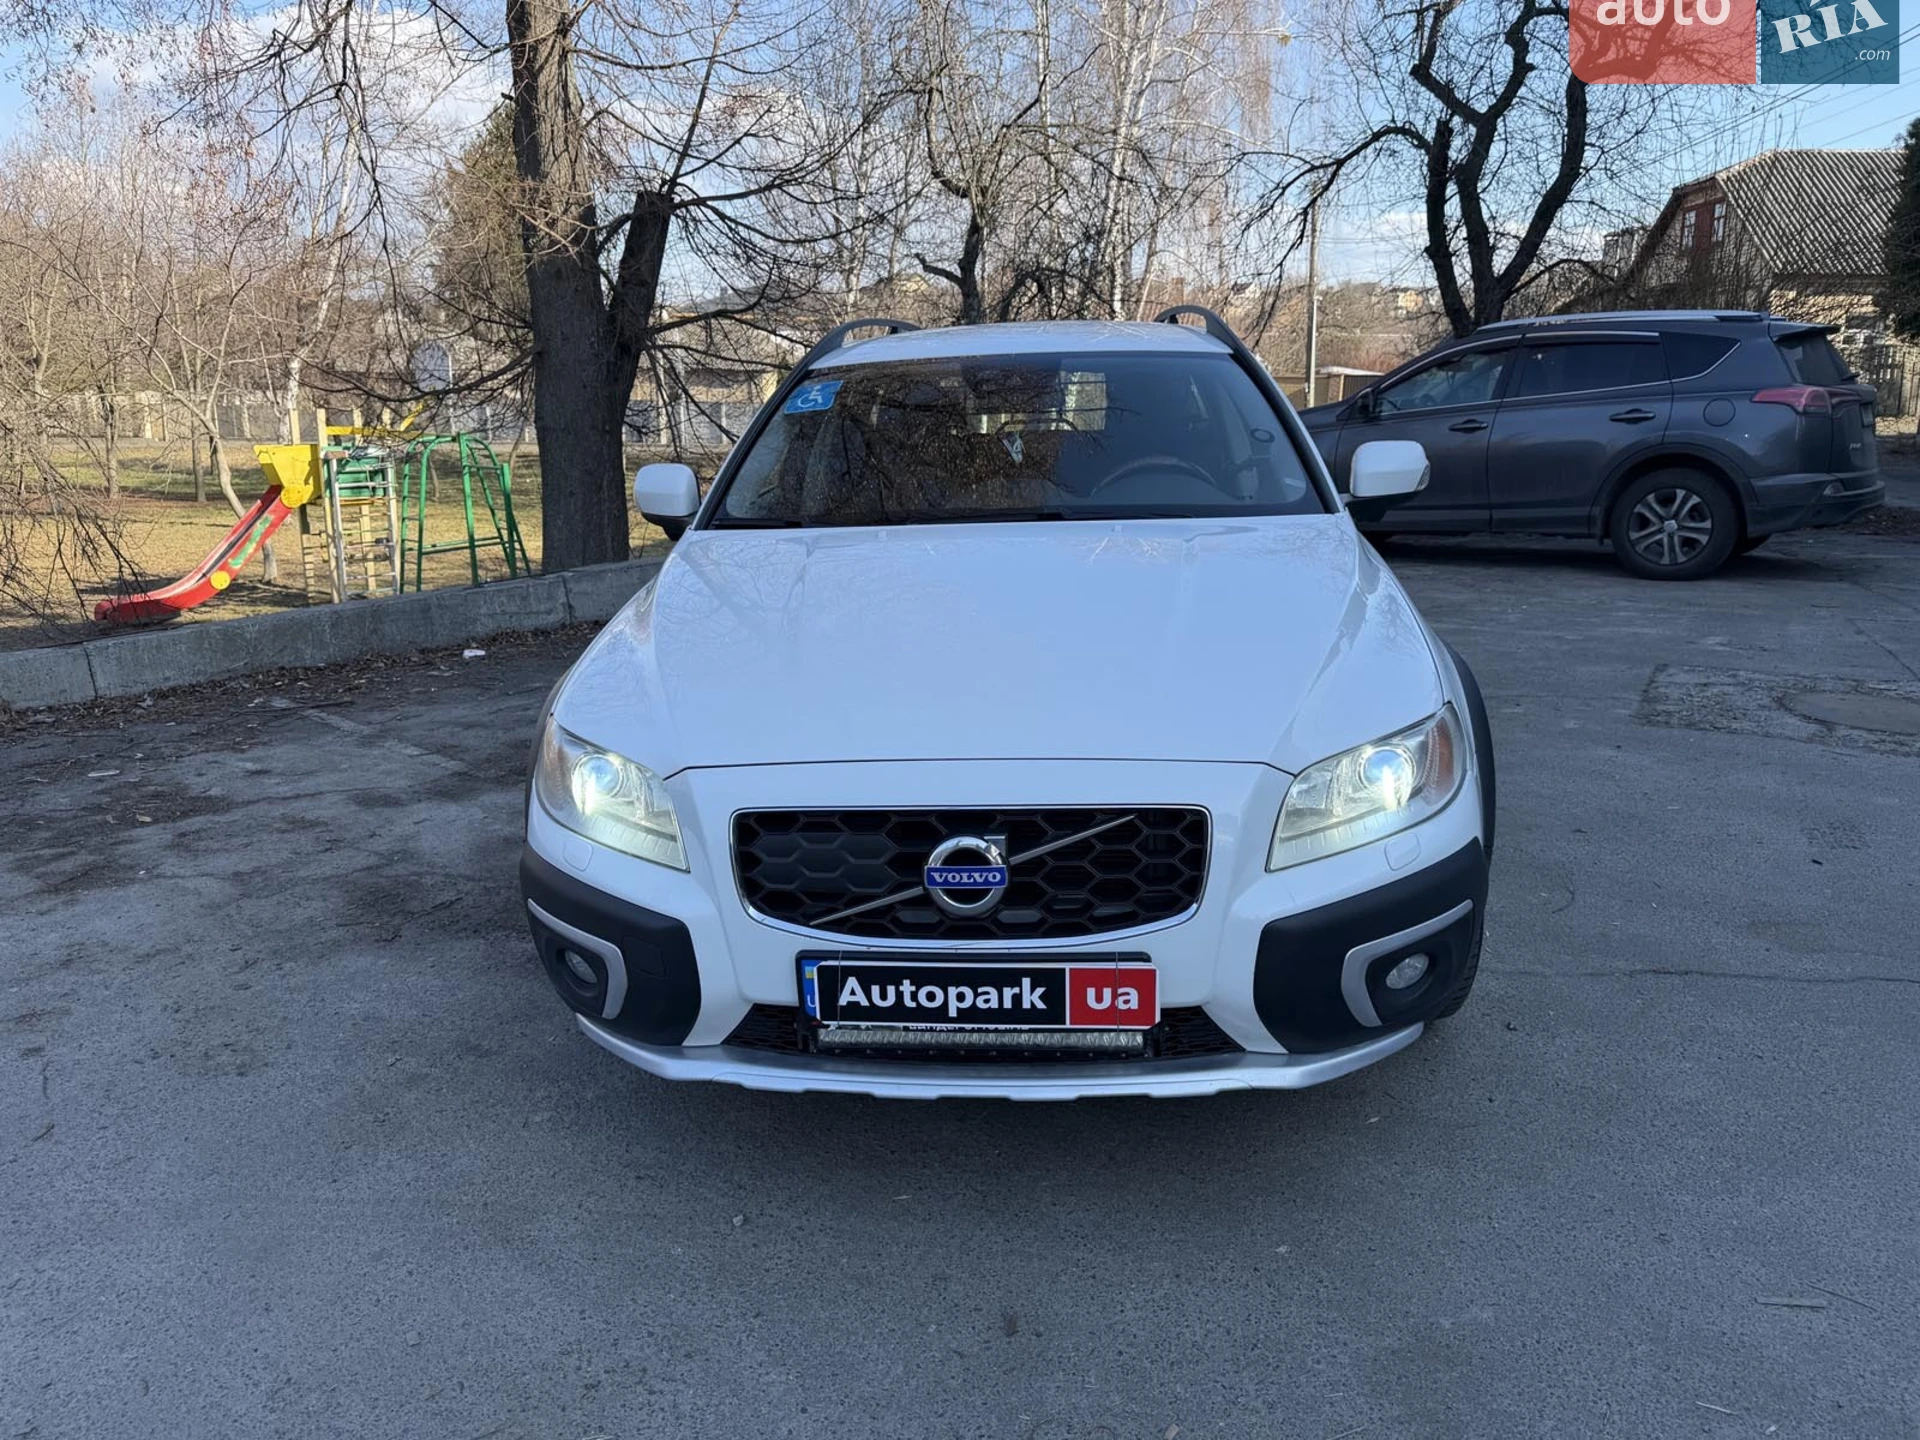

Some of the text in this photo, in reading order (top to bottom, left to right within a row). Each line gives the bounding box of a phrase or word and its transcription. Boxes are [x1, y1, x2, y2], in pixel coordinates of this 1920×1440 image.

[931, 873, 1002, 883] VOLVO
[838, 976, 1048, 1017] Autopark
[1086, 987, 1139, 1010] ua
